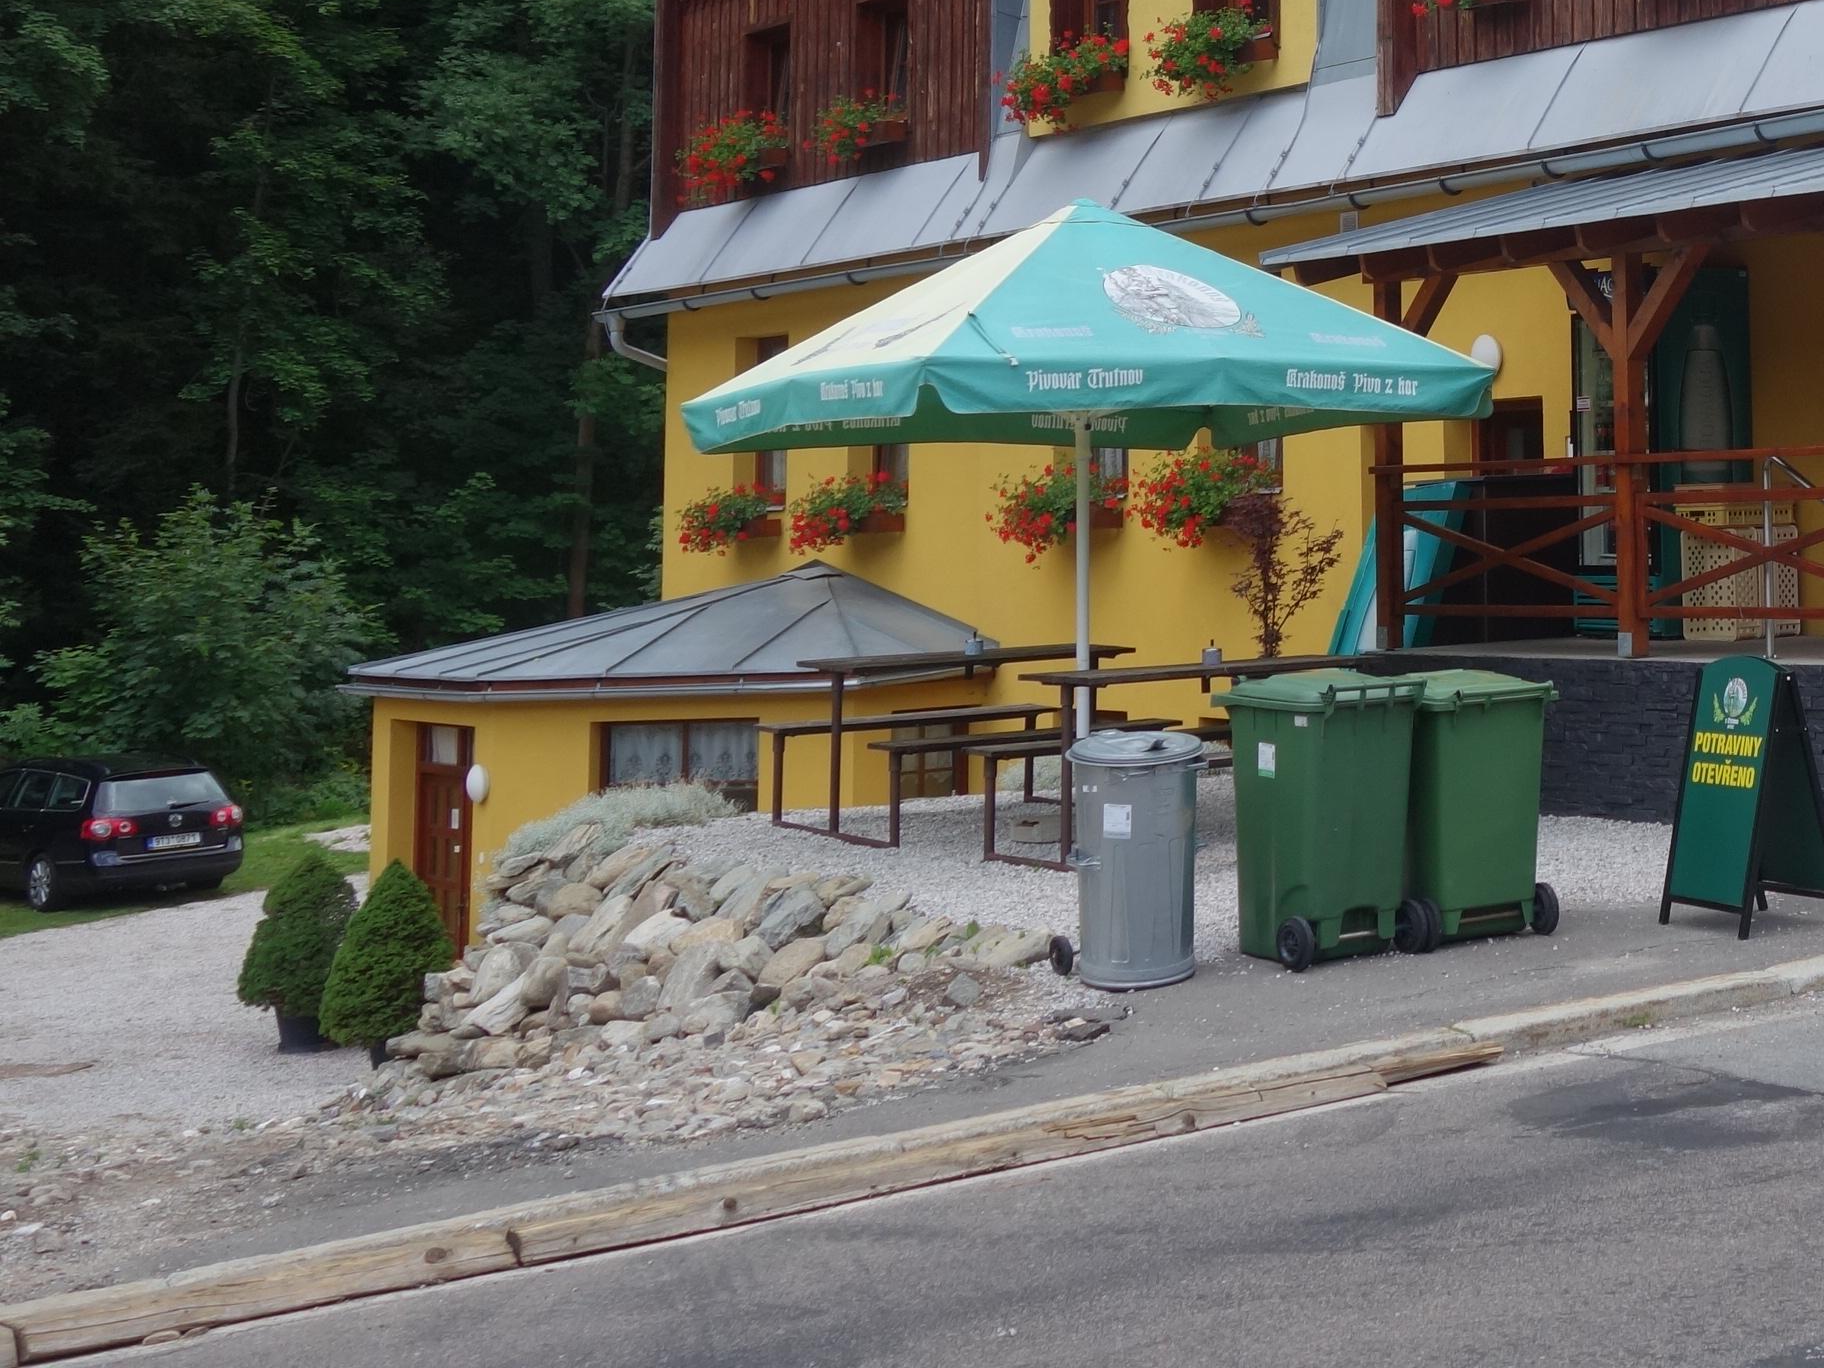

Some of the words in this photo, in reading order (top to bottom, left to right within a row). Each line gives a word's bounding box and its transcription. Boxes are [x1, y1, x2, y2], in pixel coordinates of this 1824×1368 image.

[1025, 370, 1082, 392] Pivovar
[1087, 368, 1144, 389] Trutnov
[1286, 369, 1346, 391] Krakonoš
[1353, 373, 1381, 394] Pivo
[1385, 380, 1393, 394] z
[1398, 378, 1419, 396] hor
[1694, 732, 1762, 758] POTRAVINY
[1692, 759, 1755, 788] OTEVŘENO
